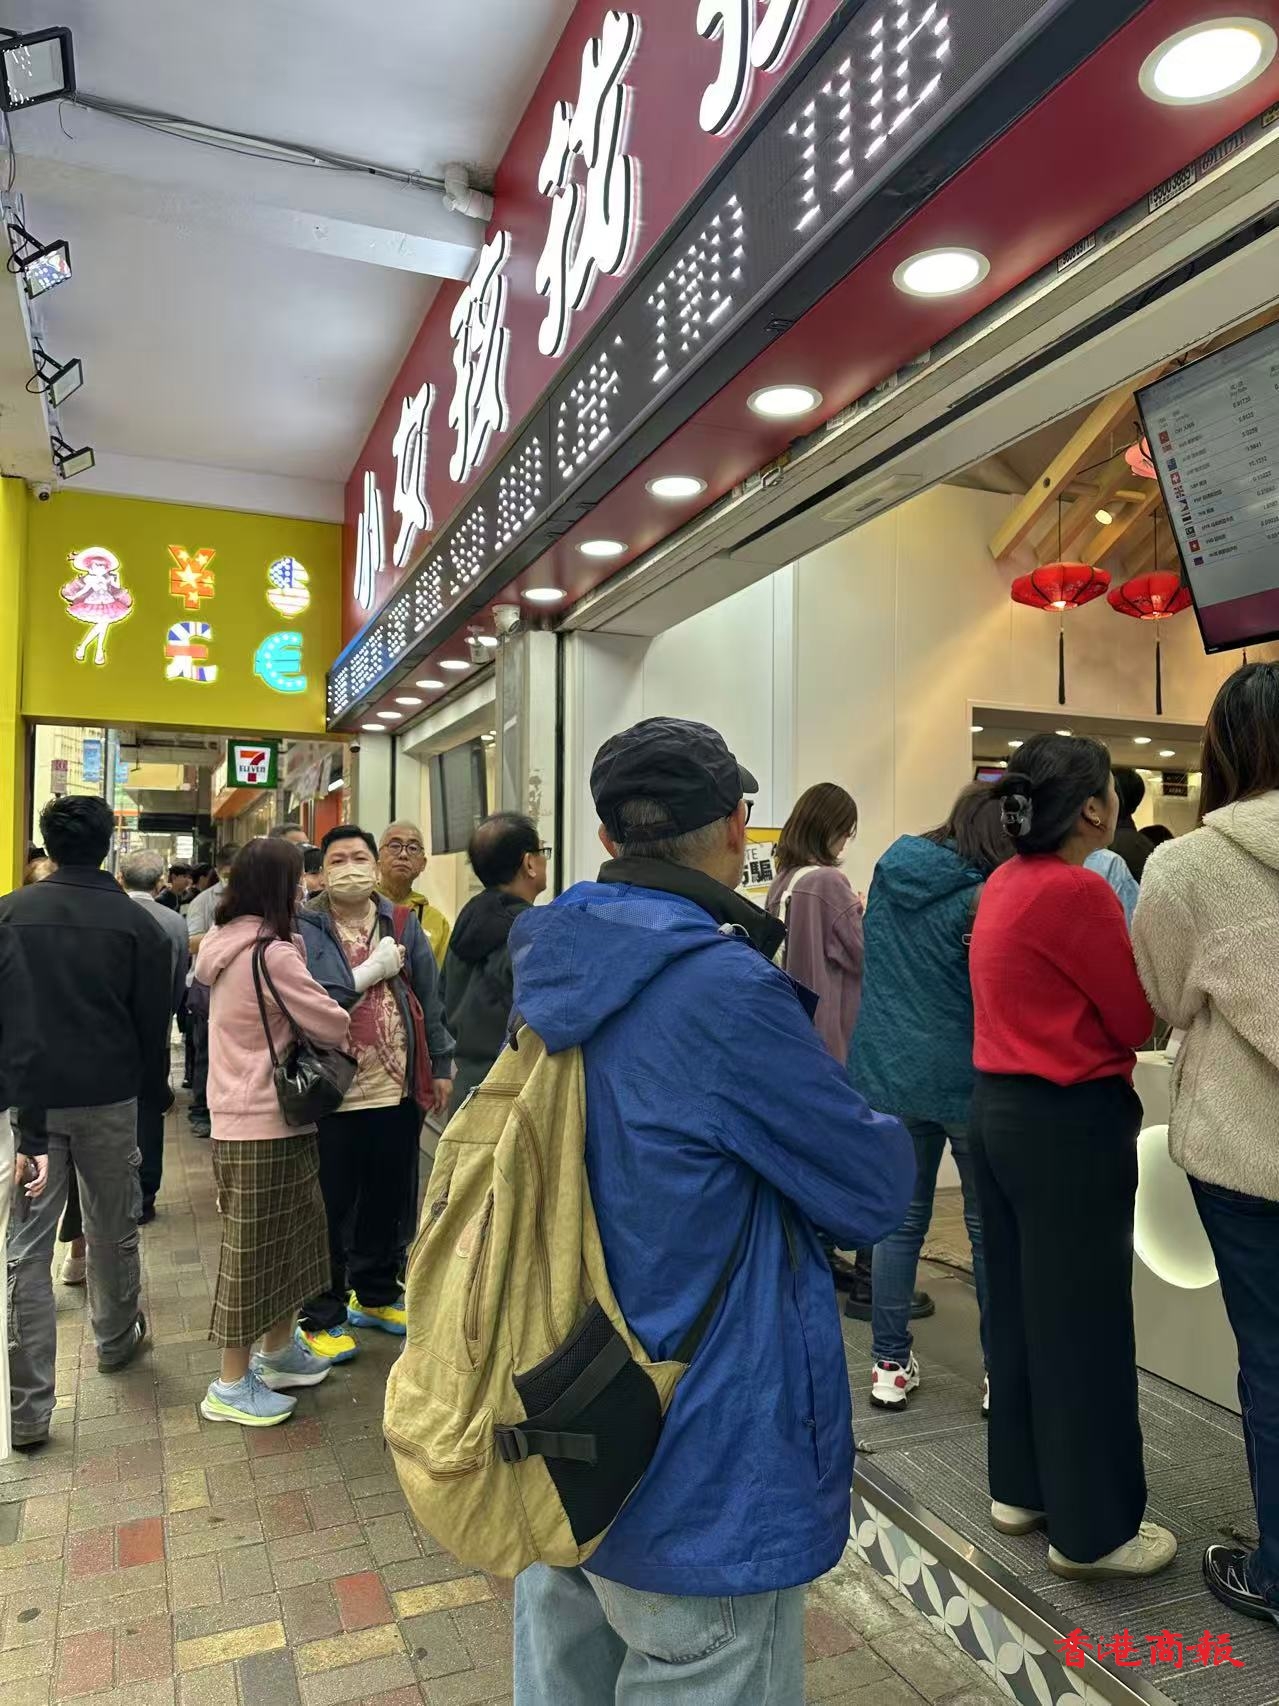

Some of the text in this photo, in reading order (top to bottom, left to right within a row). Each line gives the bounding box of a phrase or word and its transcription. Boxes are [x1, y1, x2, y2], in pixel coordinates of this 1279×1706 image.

[354, 0, 806, 610] 小女孩找
[240, 750, 266, 782] 7
